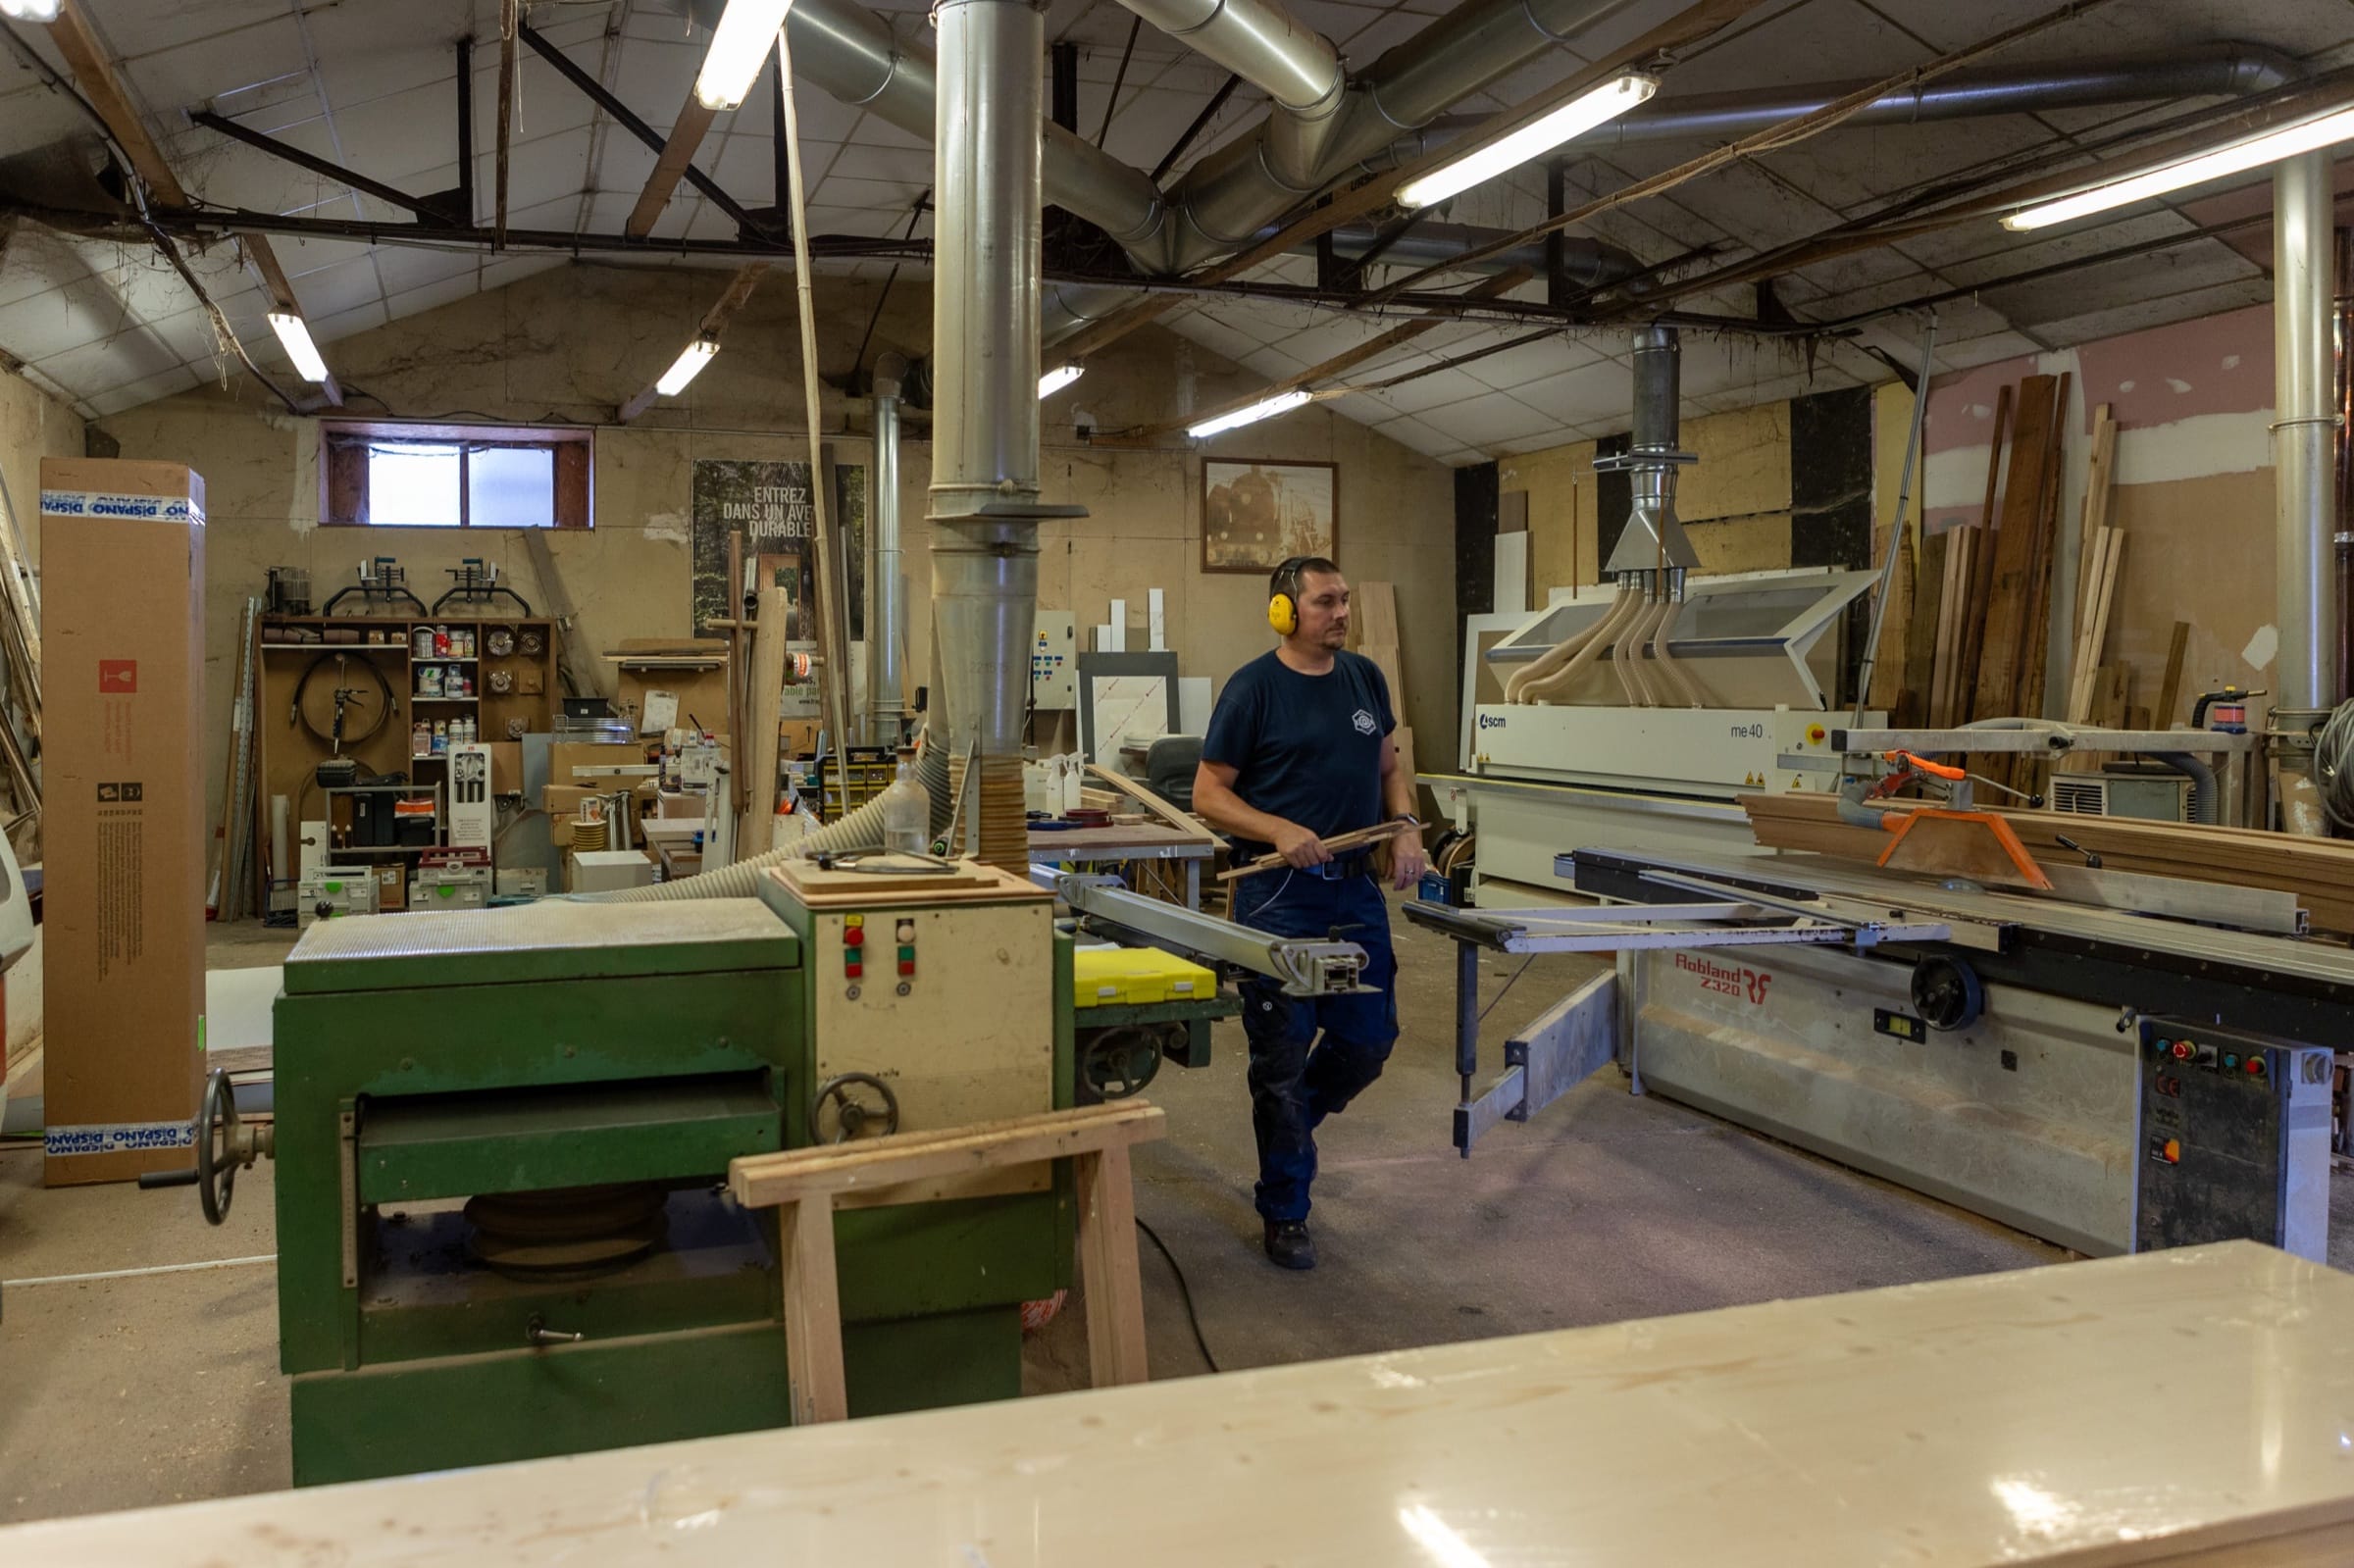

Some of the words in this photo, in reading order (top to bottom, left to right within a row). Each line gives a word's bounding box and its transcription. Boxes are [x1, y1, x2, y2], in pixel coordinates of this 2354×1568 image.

[753, 486, 806, 504] ENTREZ
[723, 503, 761, 520] DANS
[765, 504, 784, 521] UN
[787, 504, 812, 522] AVE
[749, 521, 811, 537] DURABLE
[1488, 717, 1507, 729] scm
[1730, 726, 1748, 738] me
[1748, 723, 1764, 738] 40
[1675, 952, 1742, 984] Robland
[1700, 976, 1741, 997] Z320
